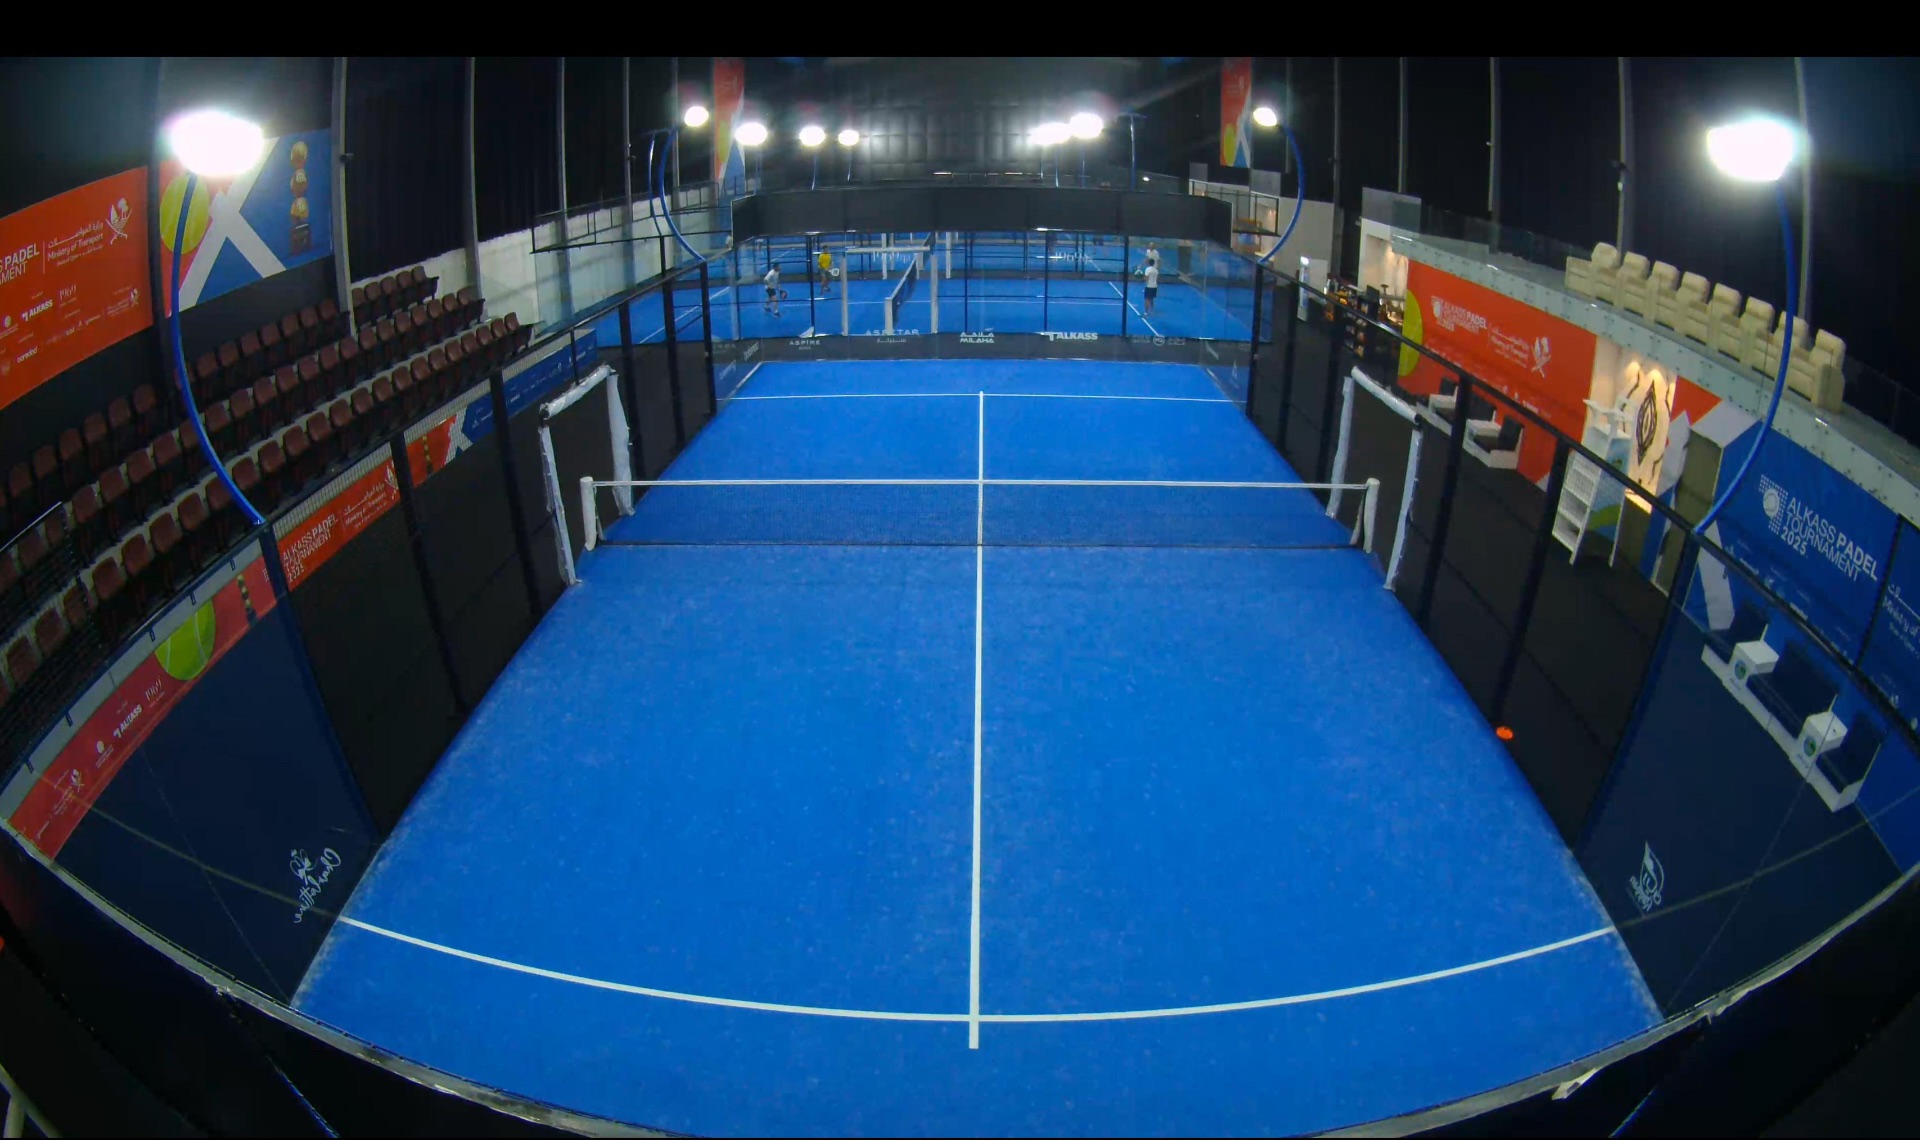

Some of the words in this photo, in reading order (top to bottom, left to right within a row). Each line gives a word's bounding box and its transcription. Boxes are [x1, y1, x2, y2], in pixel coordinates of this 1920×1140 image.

[5, 243, 40, 270] PADEL
[1466, 311, 1488, 330] PADEL
[283, 532, 312, 560] ALKASS
[312, 514, 338, 537] PADEL
[285, 529, 331, 572] TOURNAMENT
[1781, 526, 1807, 555] 2025
[1786, 511, 1861, 581] TOURNAMENT
[1787, 497, 1836, 543] ALKASS
[1837, 532, 1878, 581] PADEL
